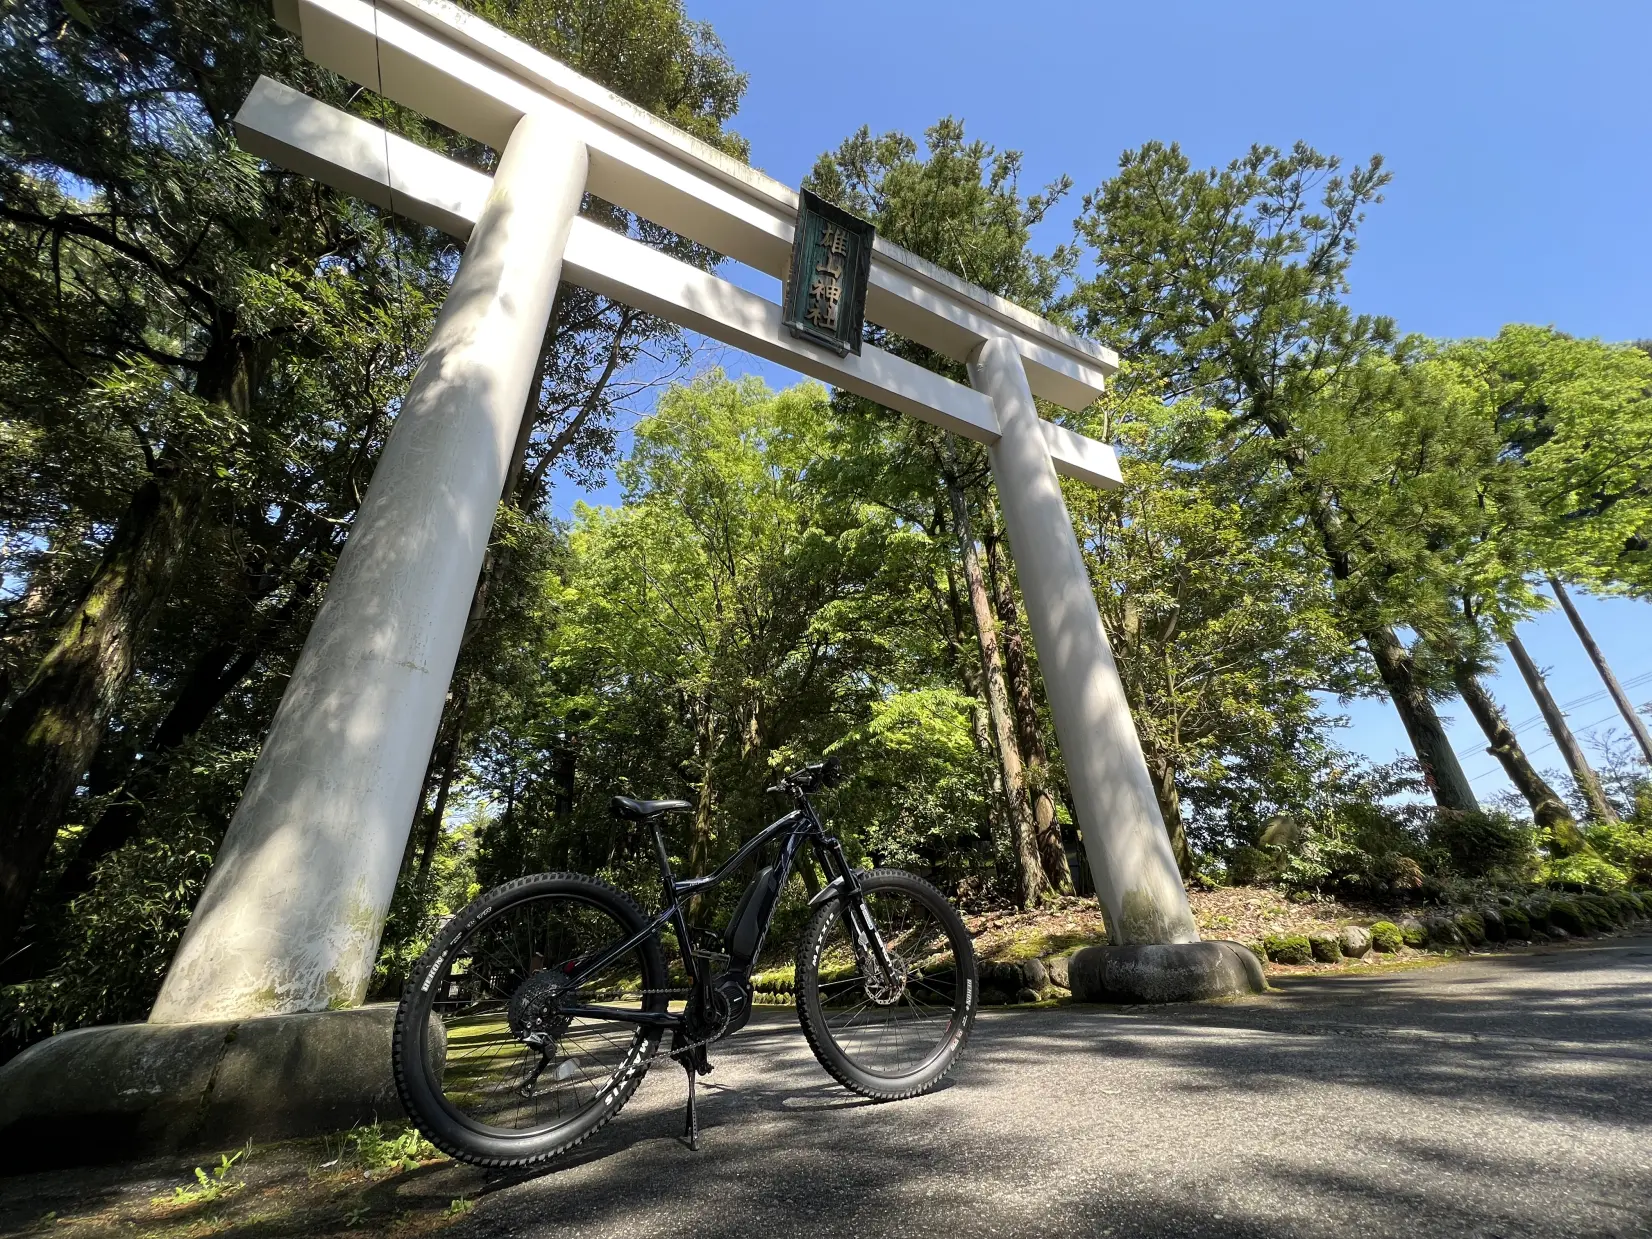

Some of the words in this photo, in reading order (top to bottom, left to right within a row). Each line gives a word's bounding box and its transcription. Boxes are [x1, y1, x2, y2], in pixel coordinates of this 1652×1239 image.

[805, 222, 847, 331] 雄山神社
[811, 912, 834, 966] MAXXIS
[605, 1038, 649, 1106] MAXXIS
